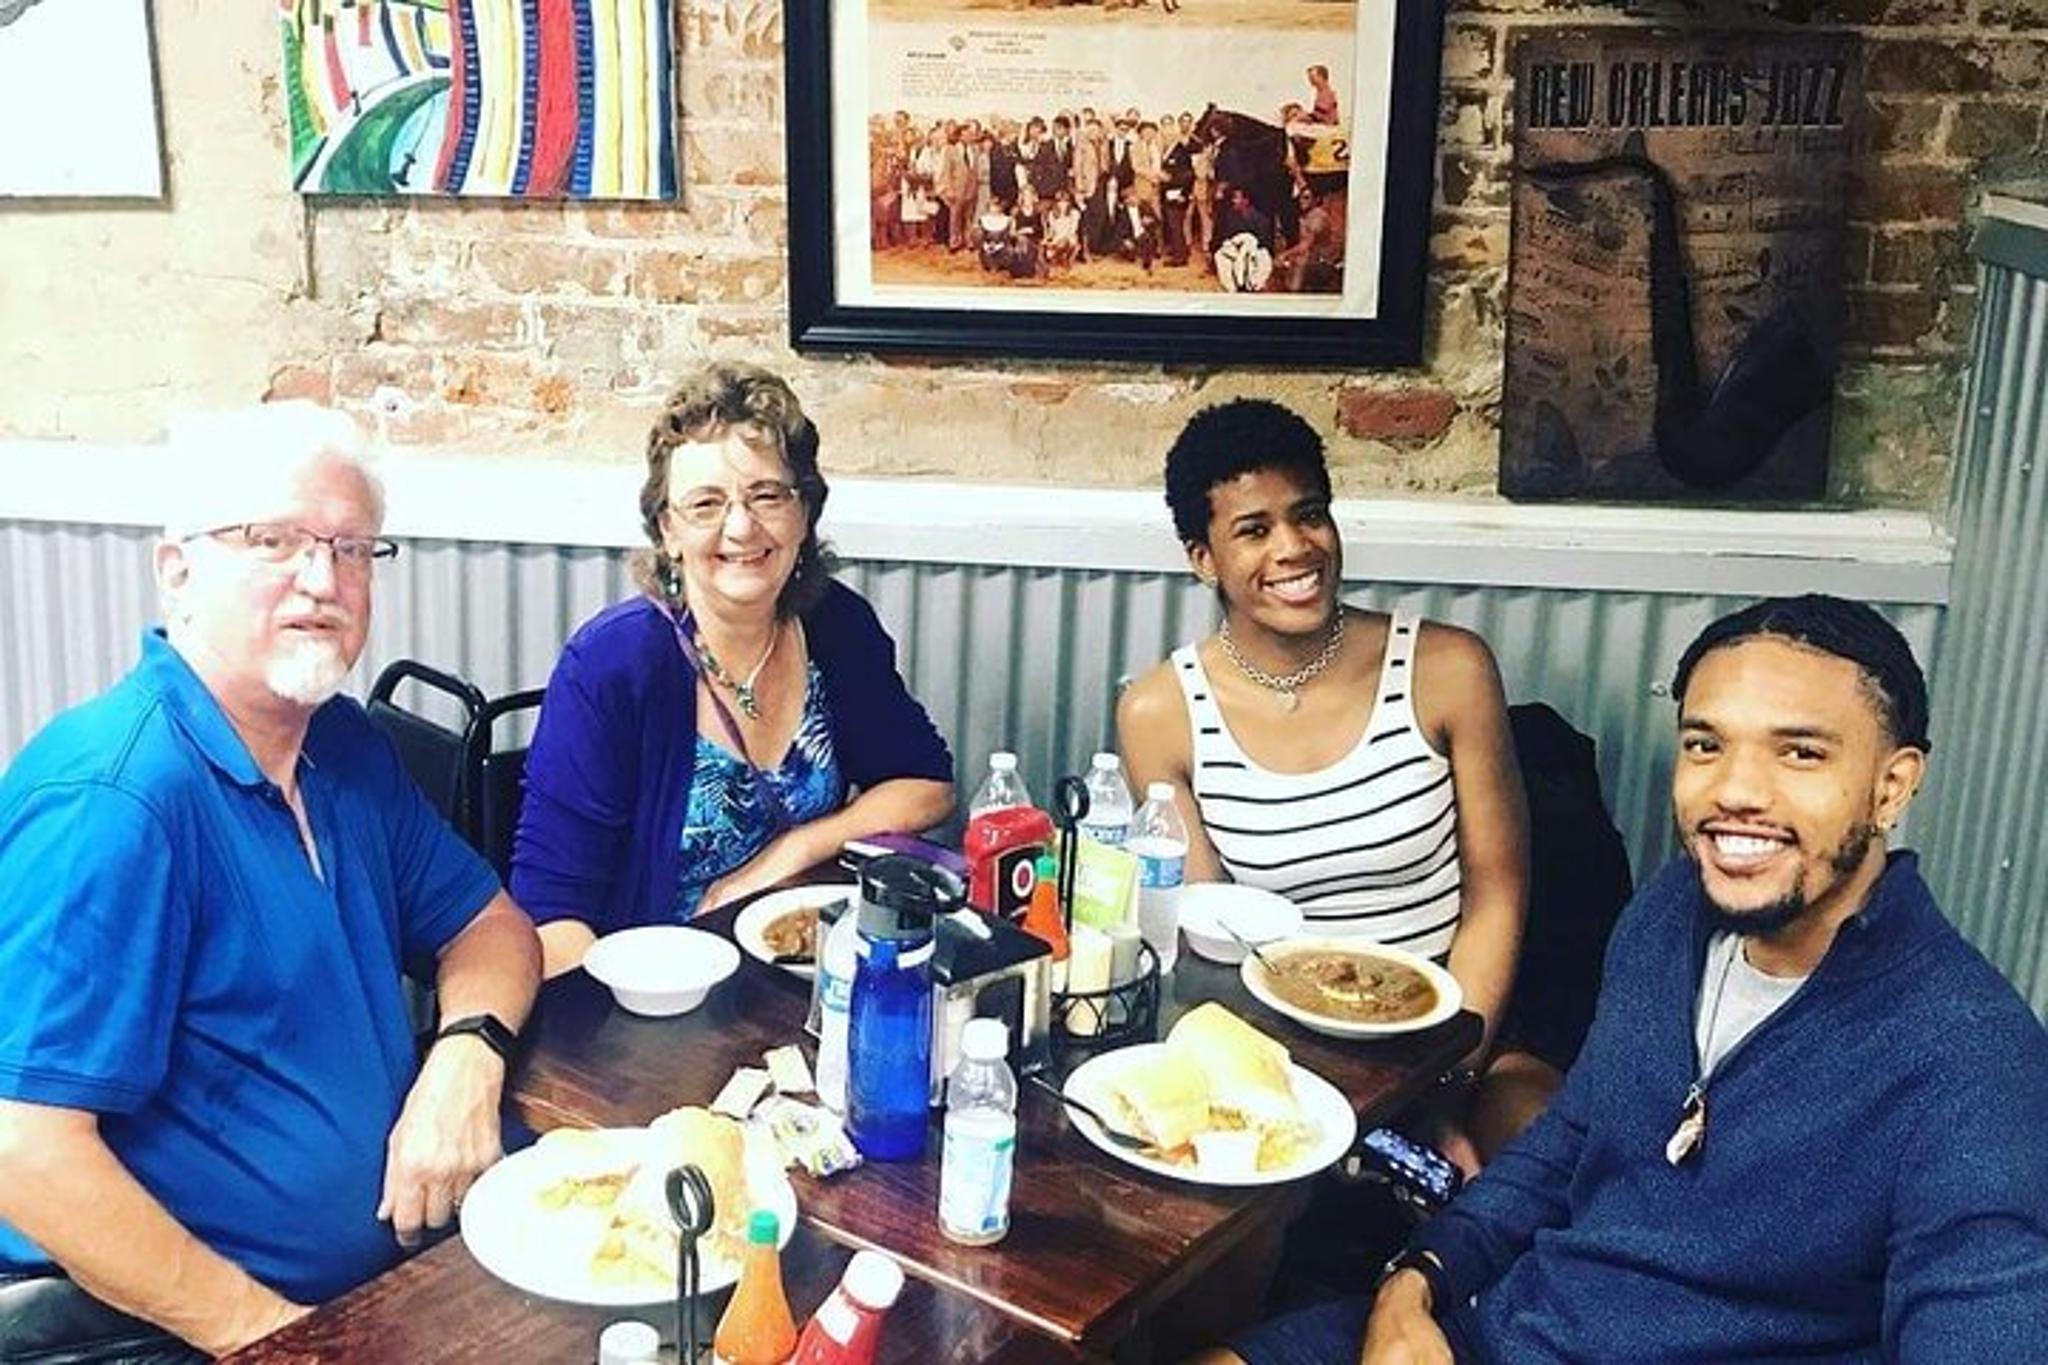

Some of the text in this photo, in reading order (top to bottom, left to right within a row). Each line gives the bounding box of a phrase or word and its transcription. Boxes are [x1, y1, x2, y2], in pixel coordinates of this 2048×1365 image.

[1529, 62, 1845, 126] NEW ORLEANS JAZZ
[1331, 139, 1350, 162] 2
